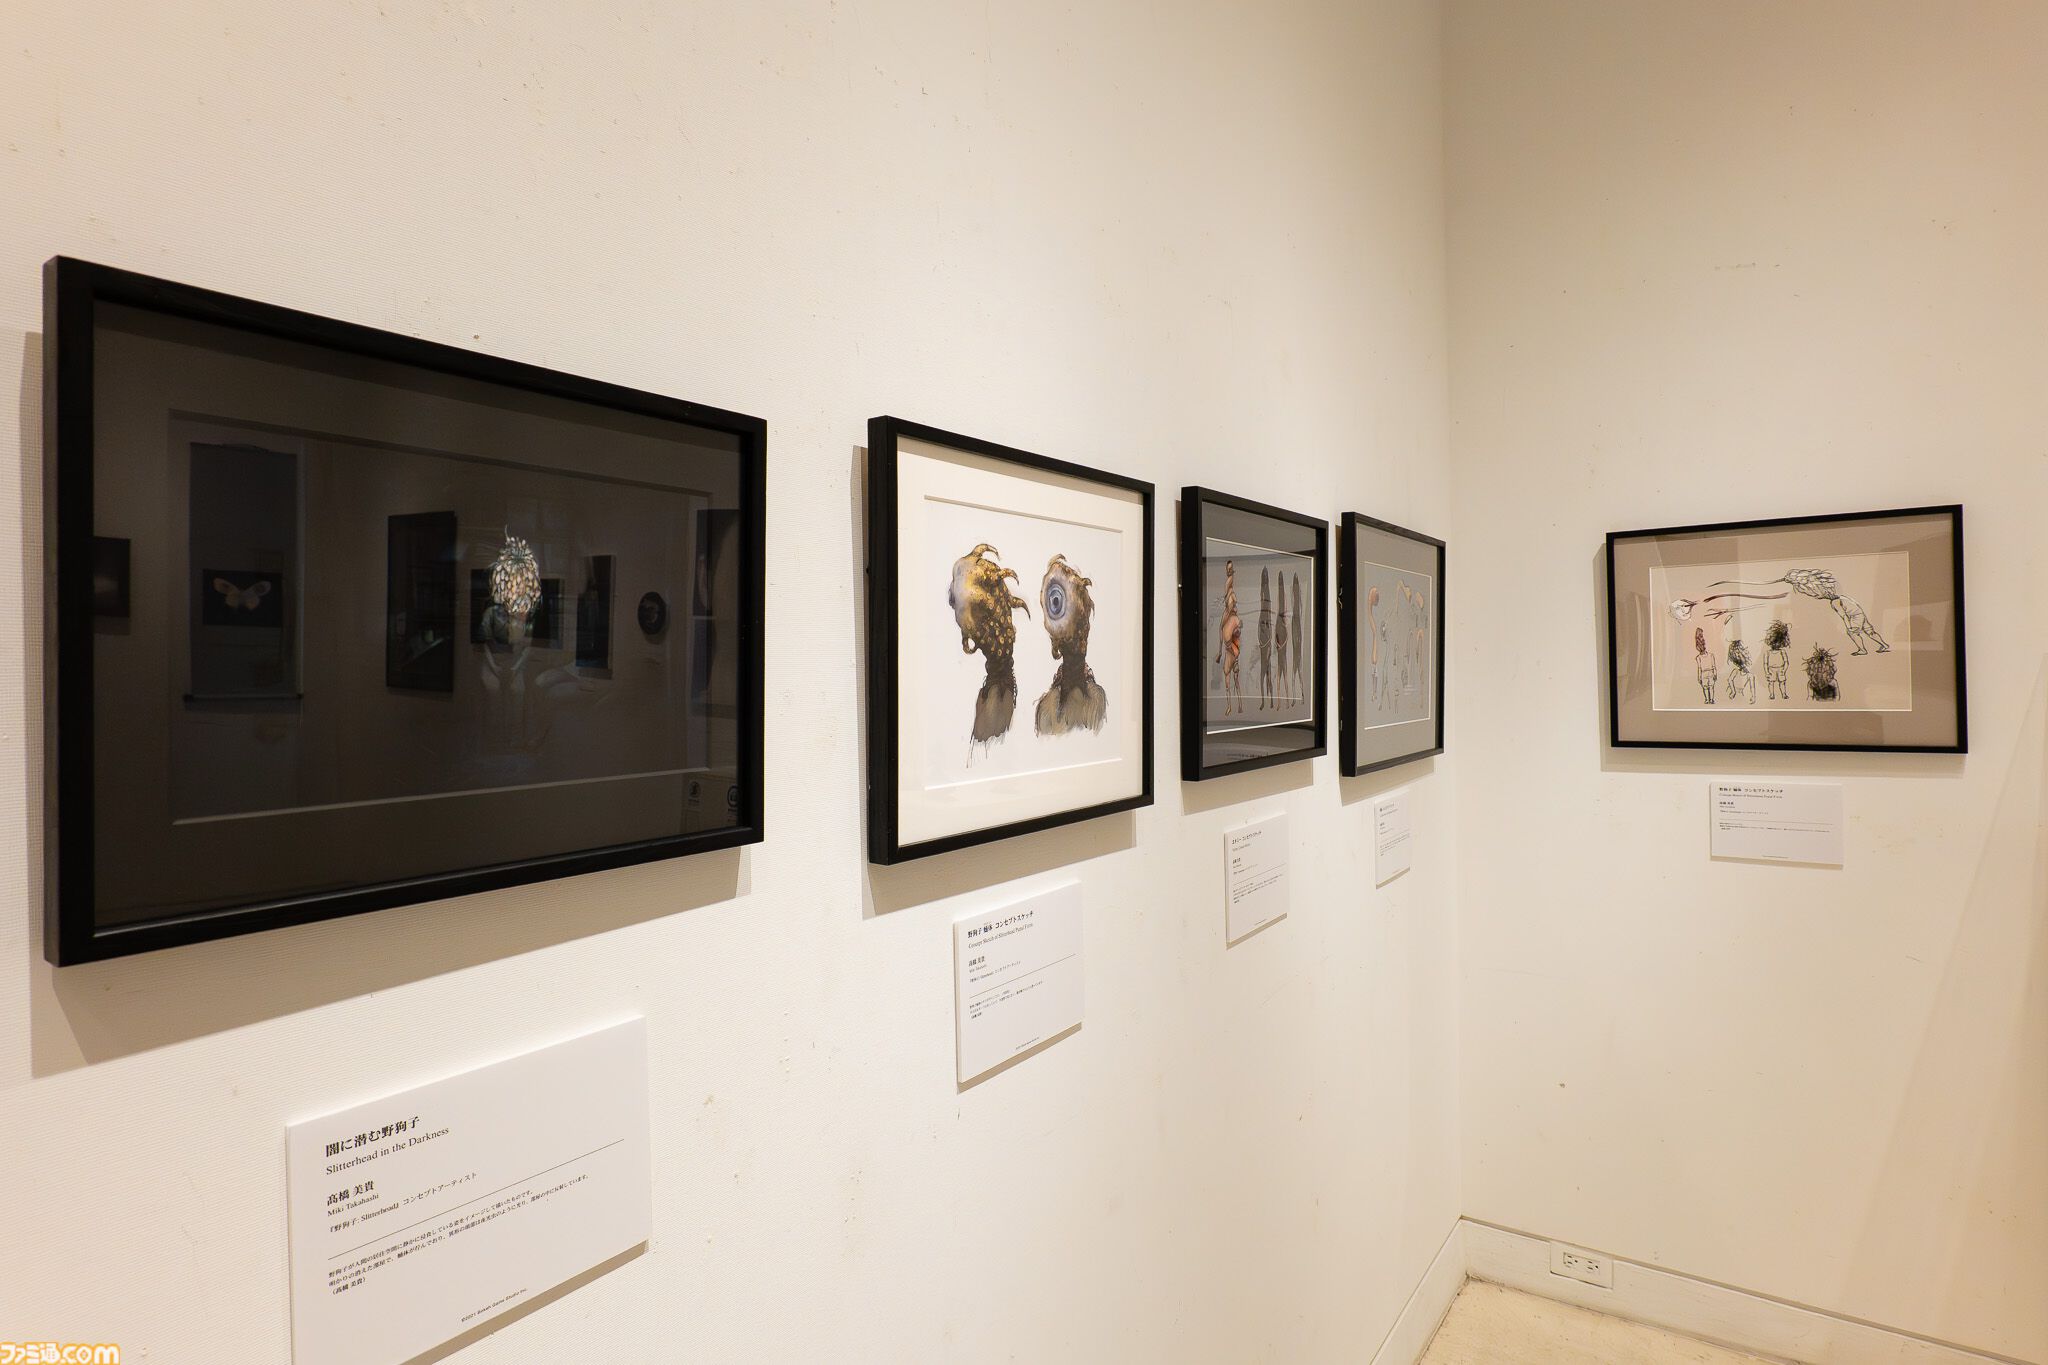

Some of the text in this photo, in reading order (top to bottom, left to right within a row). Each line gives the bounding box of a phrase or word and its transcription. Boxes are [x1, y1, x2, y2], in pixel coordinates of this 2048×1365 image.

[326, 1116, 420, 1157] 闇に潜む野狗子
[326, 1127, 450, 1175] Slitterhead in the Darkness
[327, 1193, 379, 1217] Miki Takahashi
[352, 1180, 374, 1197] 美貴
[403, 1172, 477, 1206] コンセプトアーティスト
